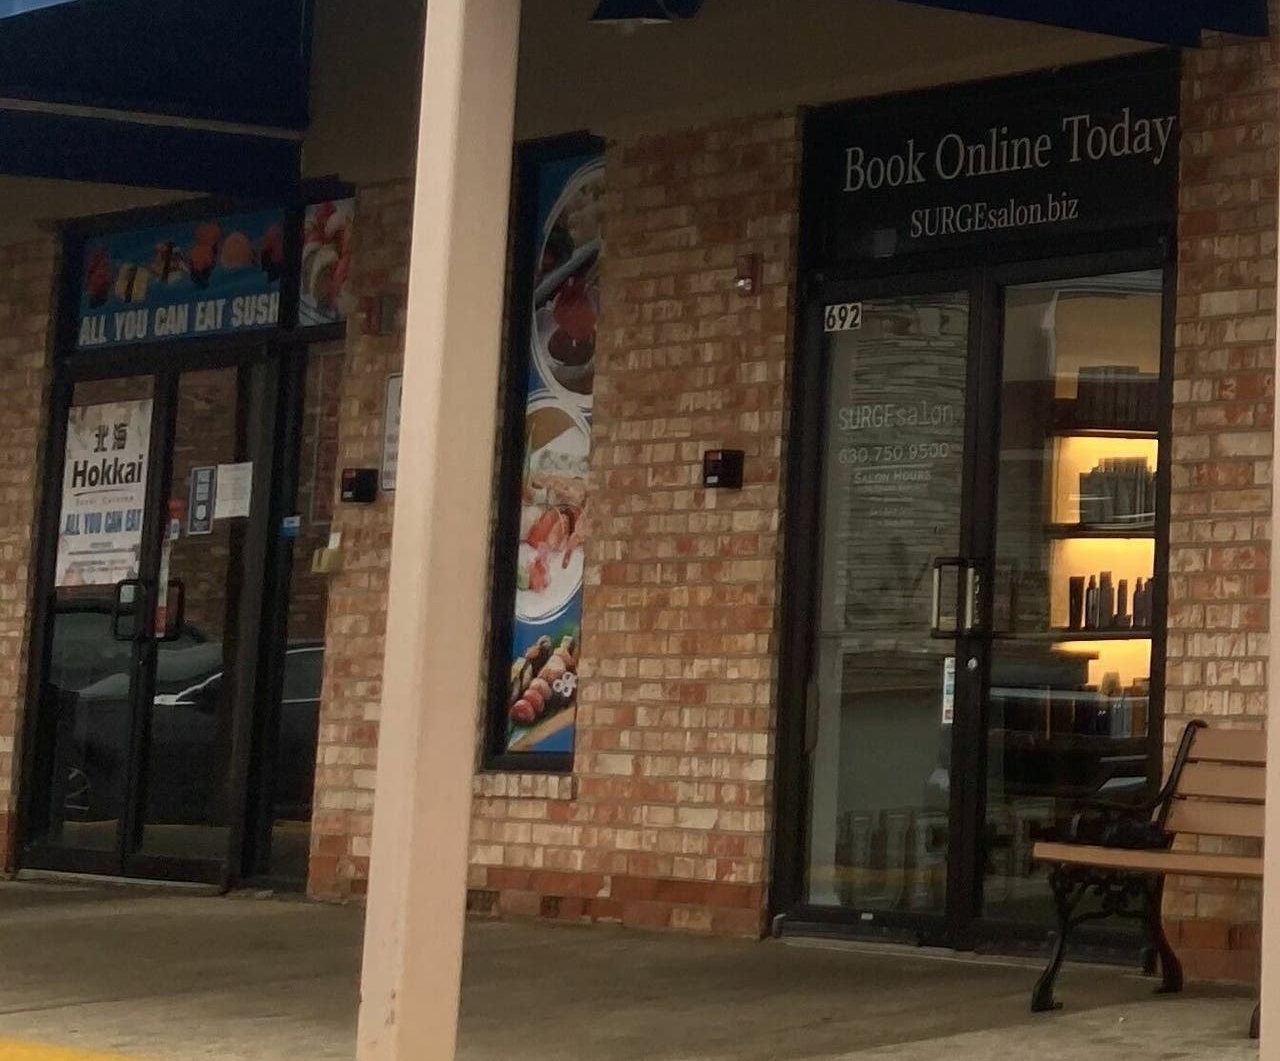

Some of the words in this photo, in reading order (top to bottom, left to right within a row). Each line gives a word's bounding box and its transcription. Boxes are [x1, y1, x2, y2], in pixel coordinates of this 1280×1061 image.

[843, 140, 927, 193] Book
[936, 126, 1052, 180] Online
[1062, 107, 1177, 166] Today
[910, 191, 1080, 238] SURGEsalon.biz
[79, 315, 108, 347] ALL
[113, 308, 149, 342] YOU
[154, 303, 189, 337] CAN
[194, 298, 227, 332] EAT
[231, 291, 281, 327] SUSH
[827, 304, 860, 329] 692
[838, 399, 953, 430] SURGEsalon
[71, 454, 144, 489] Hokkai
[65, 513, 81, 536] ALL
[84, 511, 102, 535] YOU
[104, 510, 123, 533] CAN
[125, 508, 142, 532] EAT
